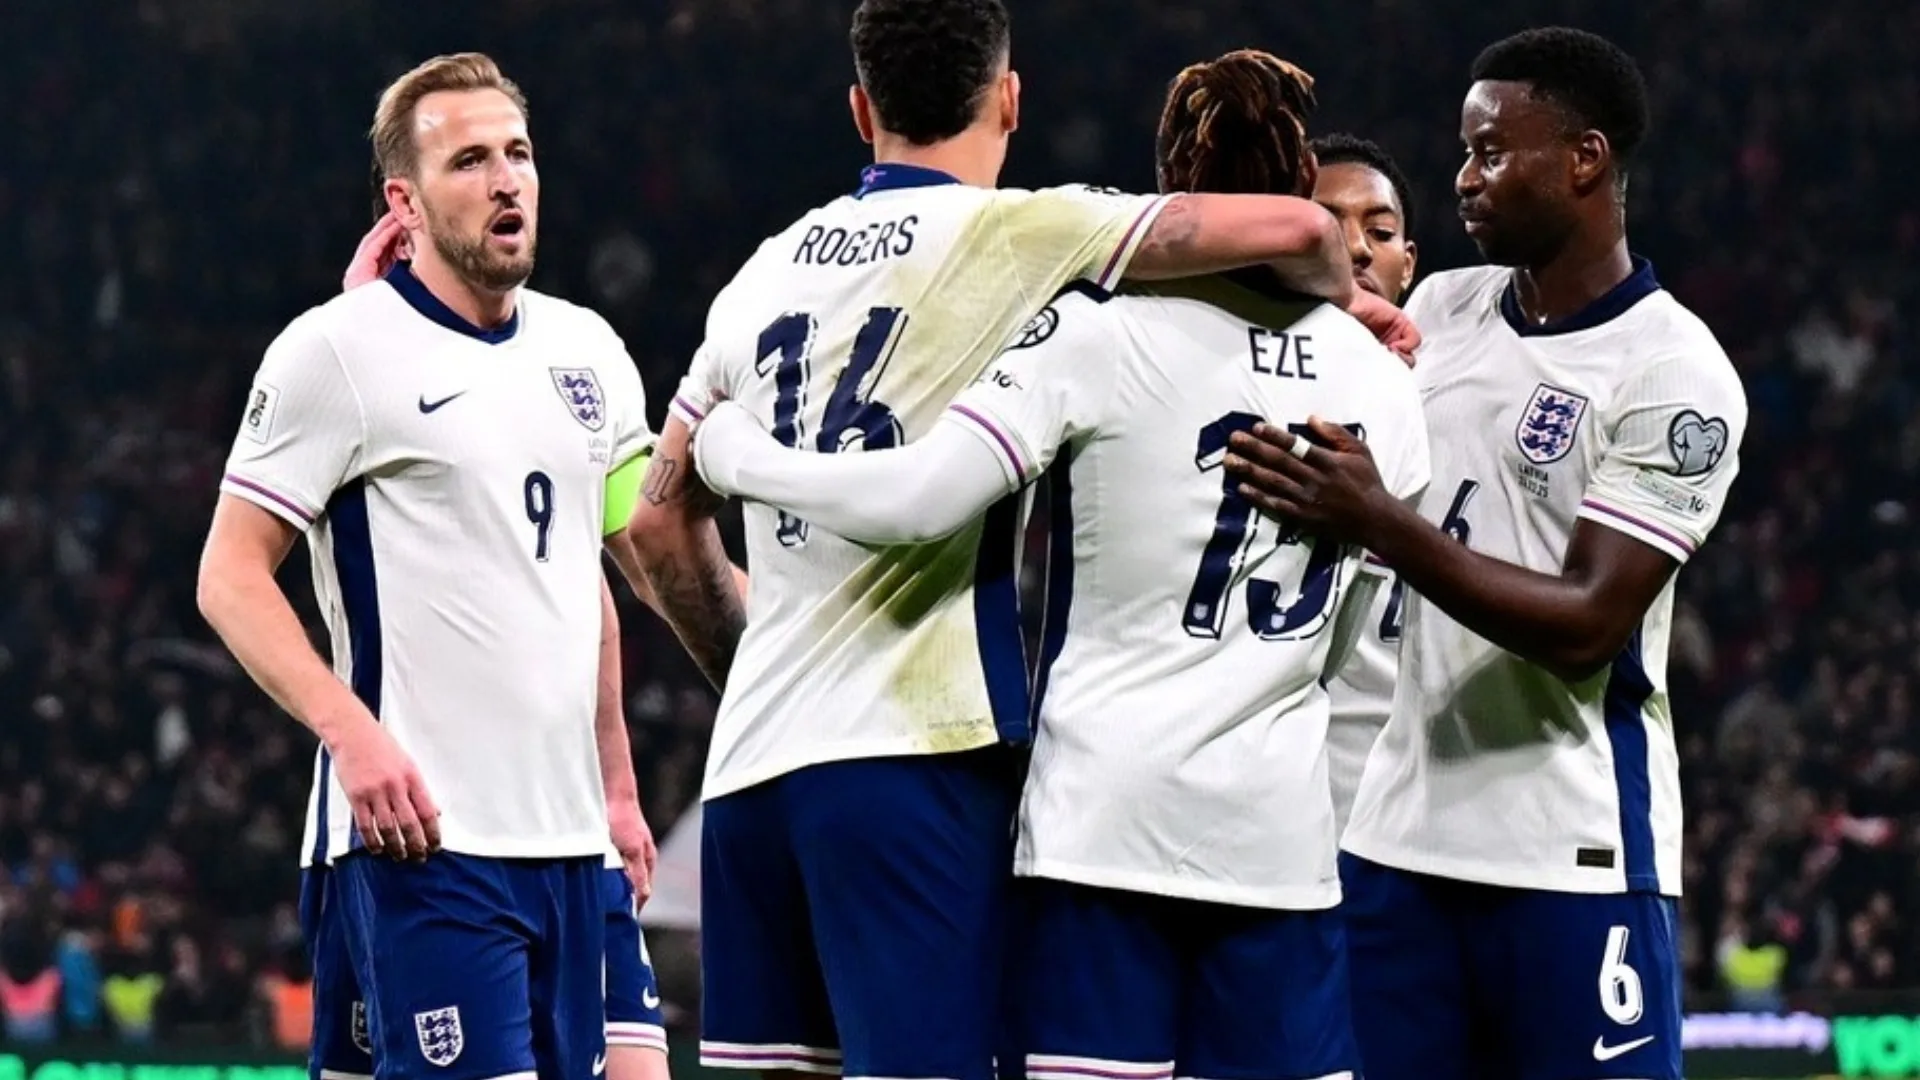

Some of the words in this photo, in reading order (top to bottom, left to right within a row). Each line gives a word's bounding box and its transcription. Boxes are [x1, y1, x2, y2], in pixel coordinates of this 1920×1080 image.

[793, 214, 919, 266] ROGERS
[1248, 327, 1317, 380] EZE
[523, 470, 555, 563] 9
[1600, 925, 1644, 1025] 6
[1831, 1015, 1920, 1080] YO
